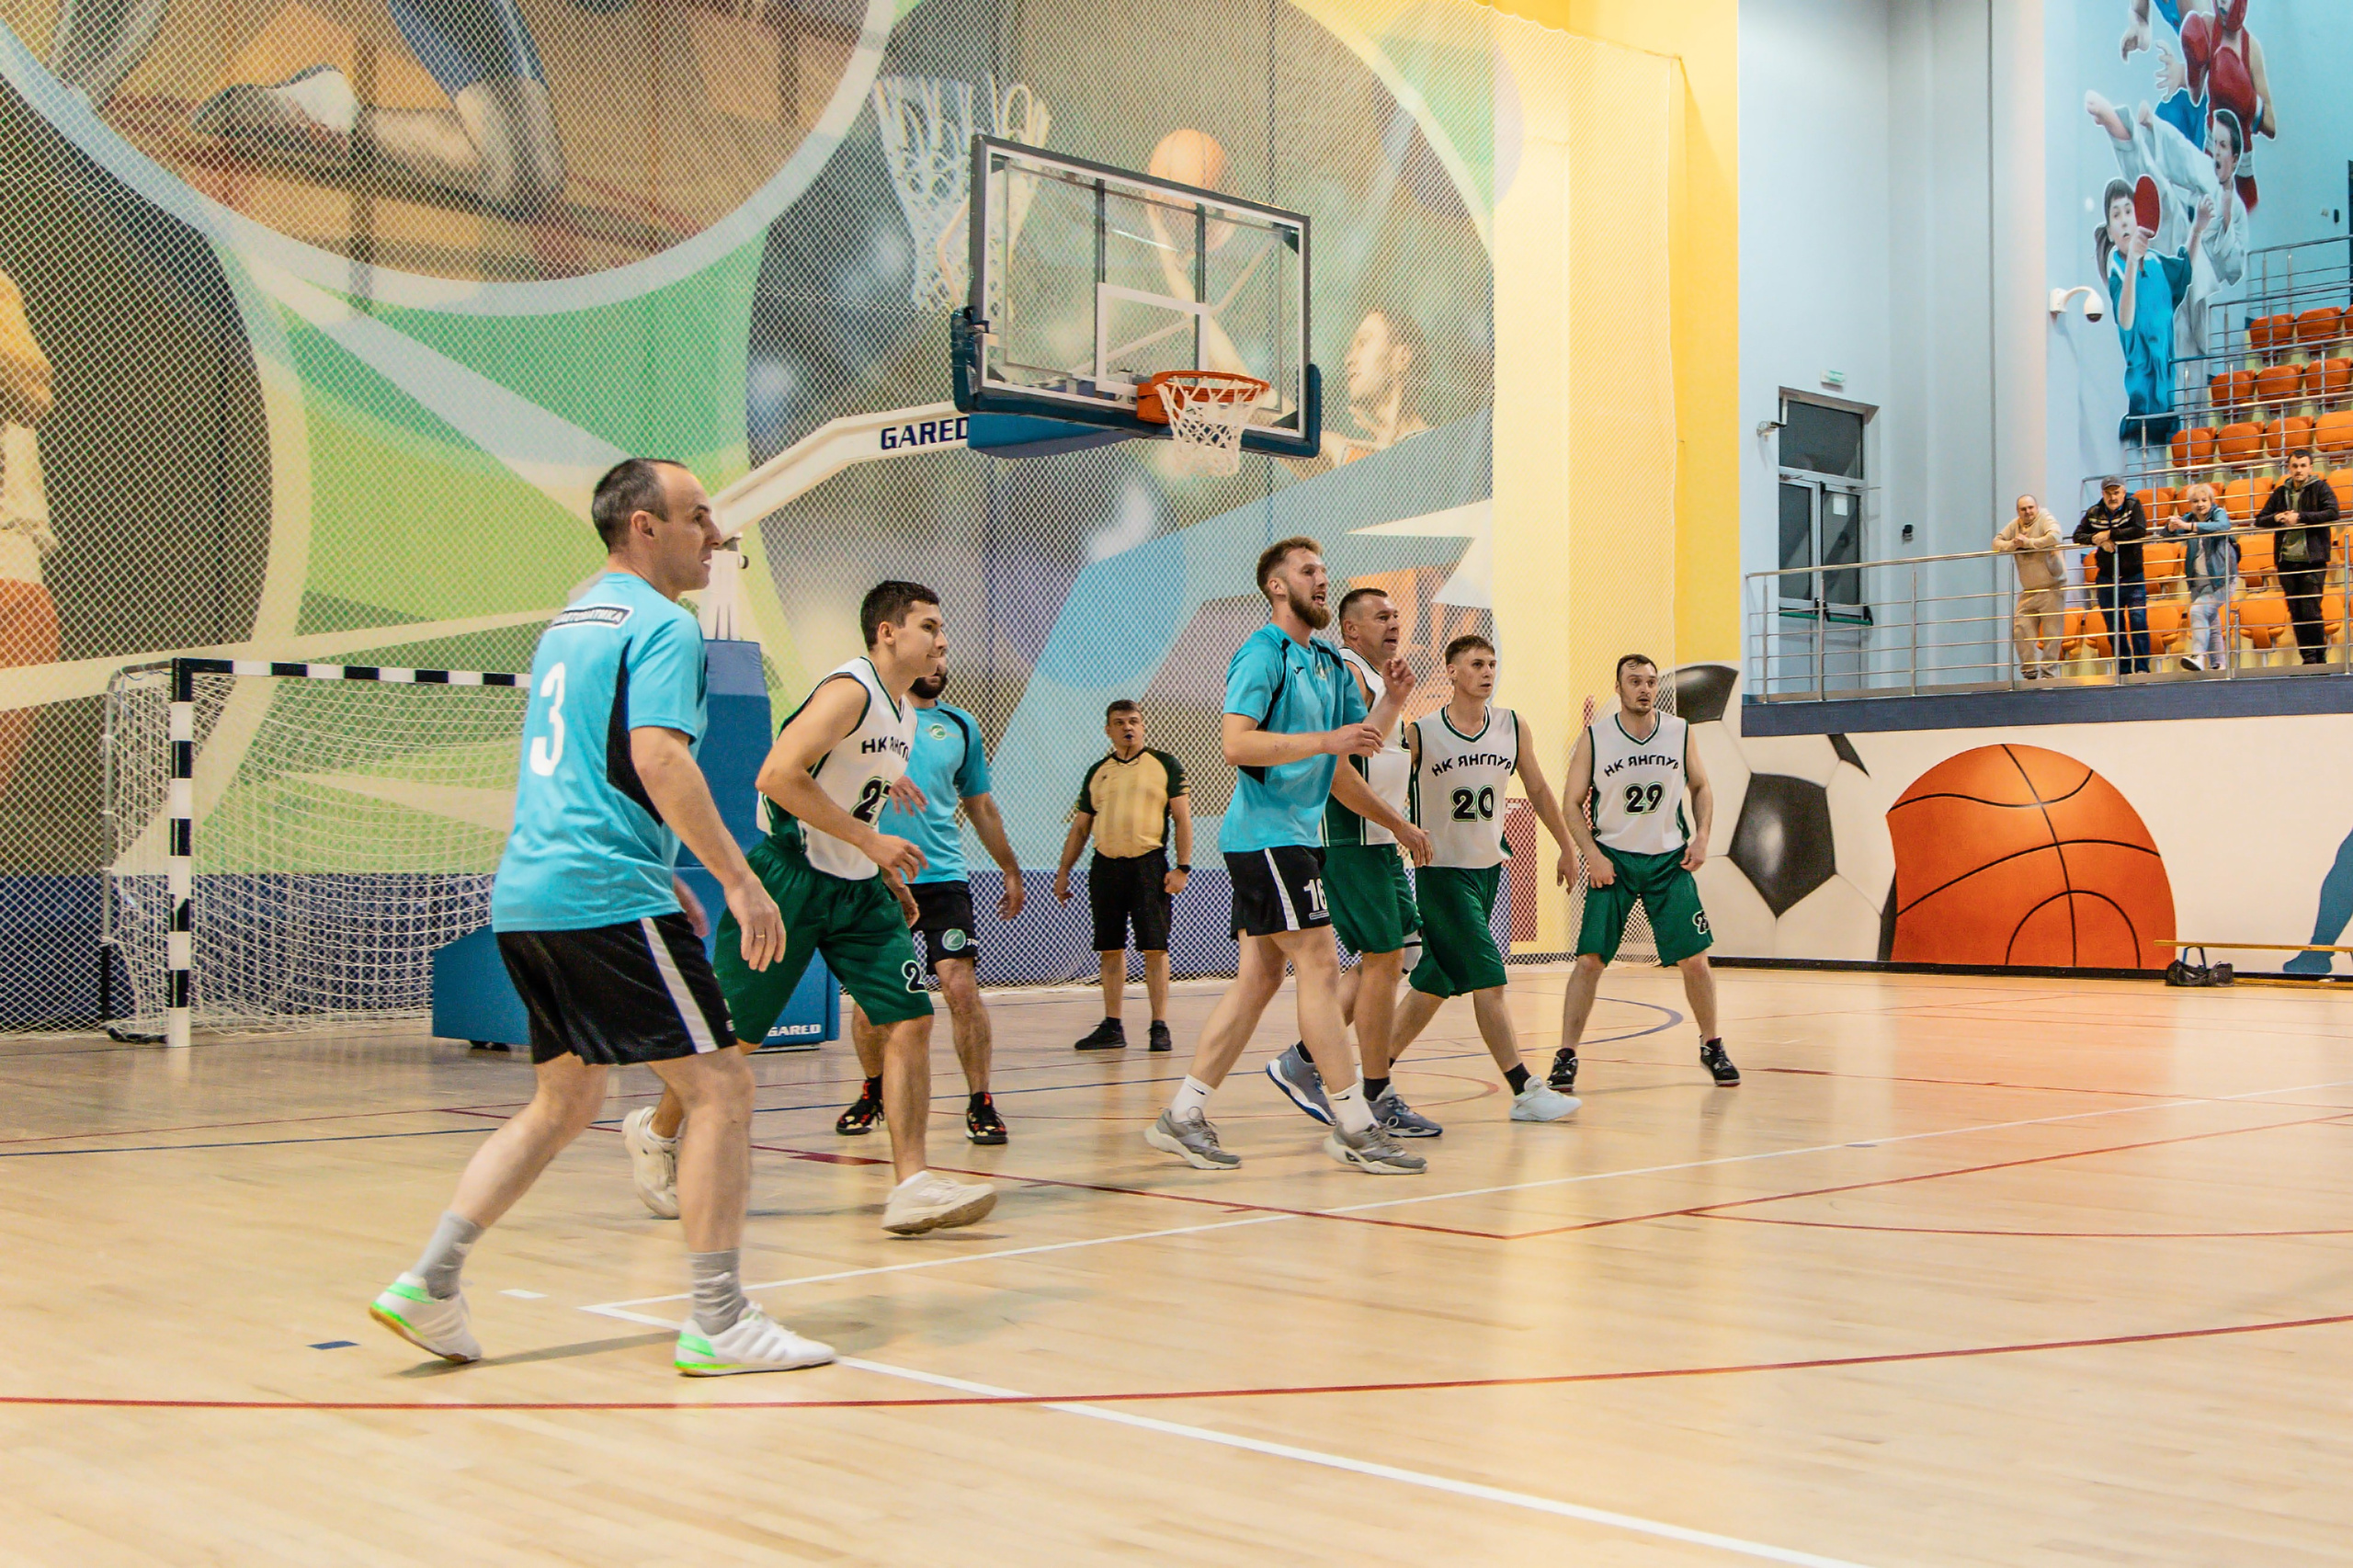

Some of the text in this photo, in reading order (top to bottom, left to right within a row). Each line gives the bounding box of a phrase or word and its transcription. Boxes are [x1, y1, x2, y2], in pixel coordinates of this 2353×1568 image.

[881, 417, 969, 450] GARED
[529, 662, 565, 776] 3
[861, 736, 887, 754] НК
[1431, 753, 1512, 777] НК ЯНГПУР
[1604, 755, 1678, 777] НК ЯНГПУР
[1451, 786, 1494, 821] 20
[1624, 783, 1664, 813] 29
[1303, 878, 1327, 911] 16
[767, 1024, 822, 1037] GARED
